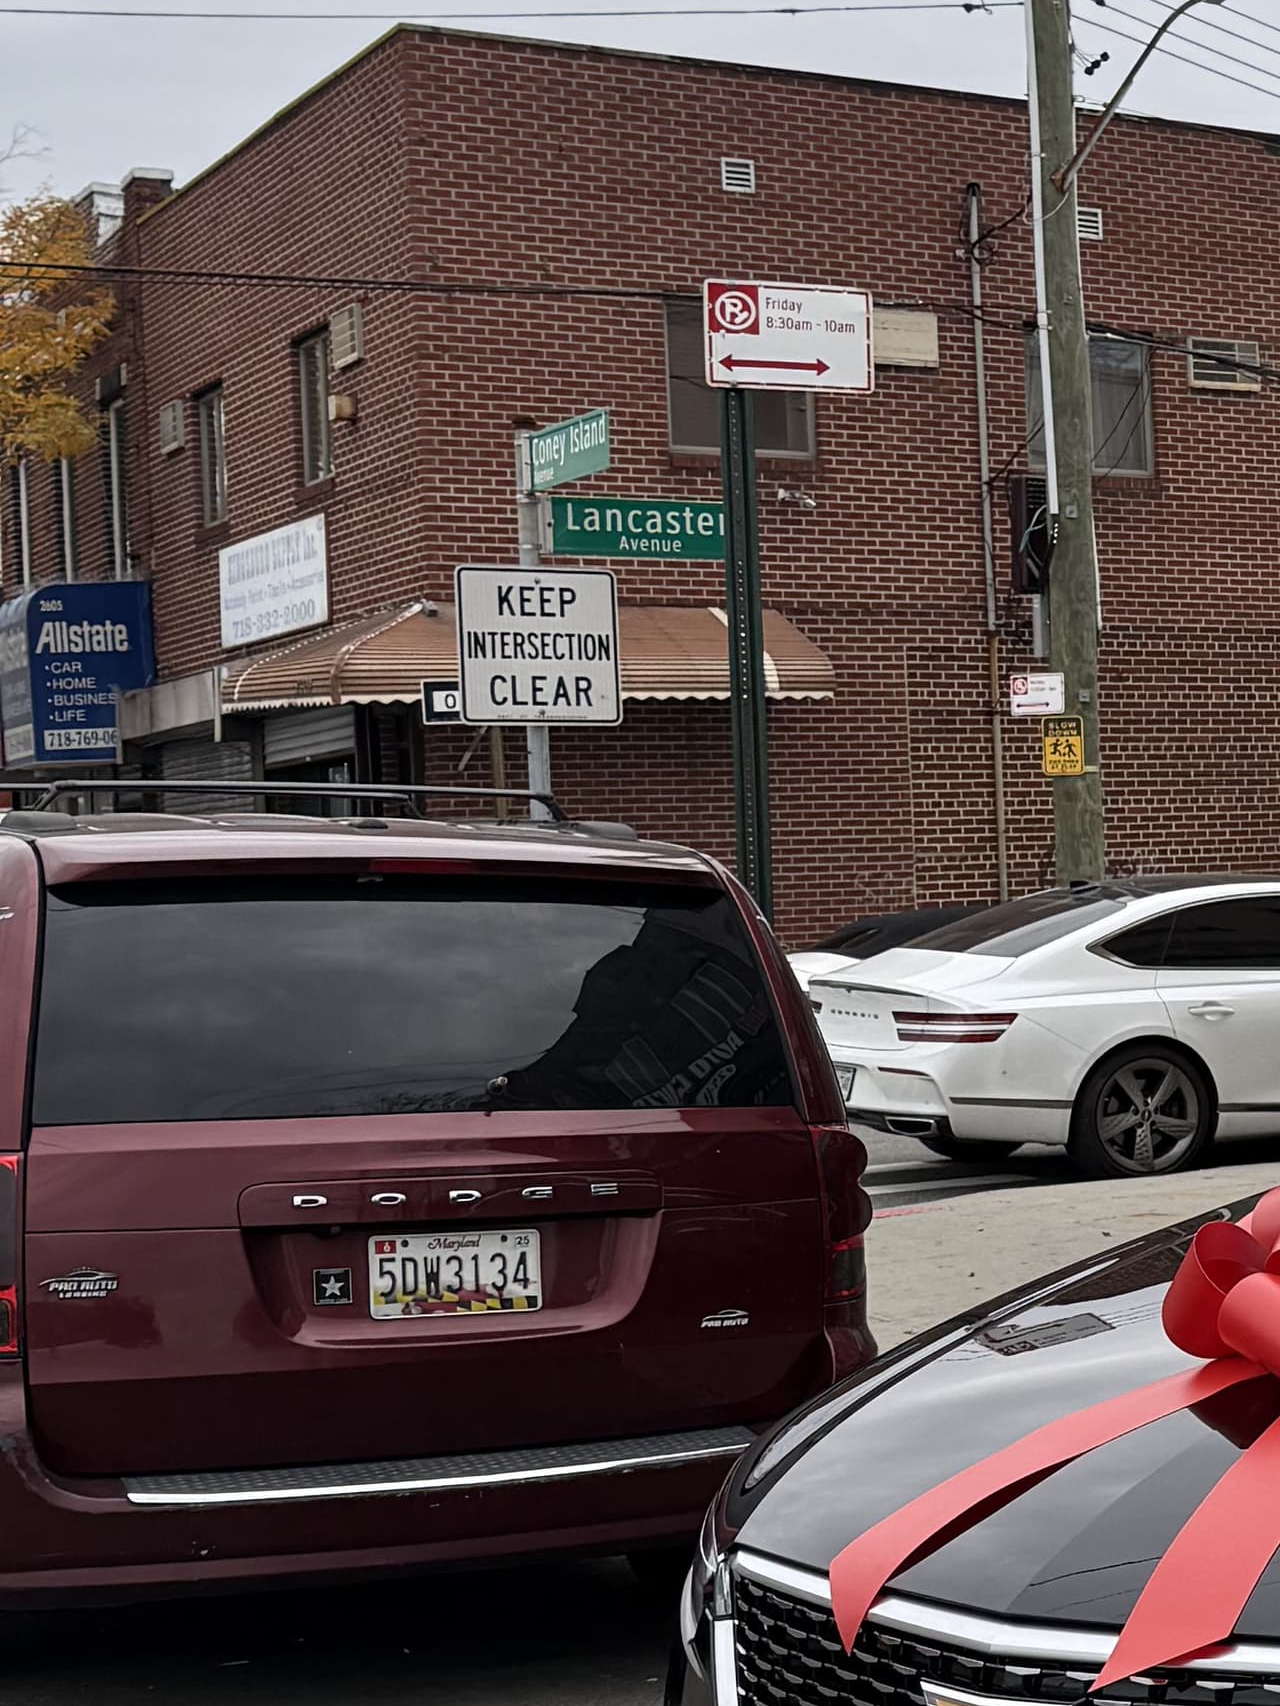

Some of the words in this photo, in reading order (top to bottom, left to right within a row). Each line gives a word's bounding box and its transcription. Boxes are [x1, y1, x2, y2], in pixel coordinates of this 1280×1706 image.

[765, 297, 803, 314] Friday
[766, 316, 813, 331] 8:30am
[824, 320, 856, 334] 10am
[532, 433, 566, 466] Coney
[570, 415, 607, 454] Island
[619, 536, 682, 553] Avenue
[497, 585, 576, 618] KEEP
[35, 620, 129, 654] Allstate
[467, 630, 611, 661] INTERSECTION
[51, 661, 82, 673] CAR
[53, 677, 97, 689] HOME
[489, 675, 593, 707] CLEAR
[54, 693, 117, 706] BUSINES
[55, 710, 87, 722] LIFE
[48, 730, 117, 747] 718-769-06
[293, 1183, 619, 1207] DODGE
[428, 1234, 481, 1252] Maryland
[515, 1236, 530, 1246] 25
[379, 1251, 530, 1298] 5DW3134
